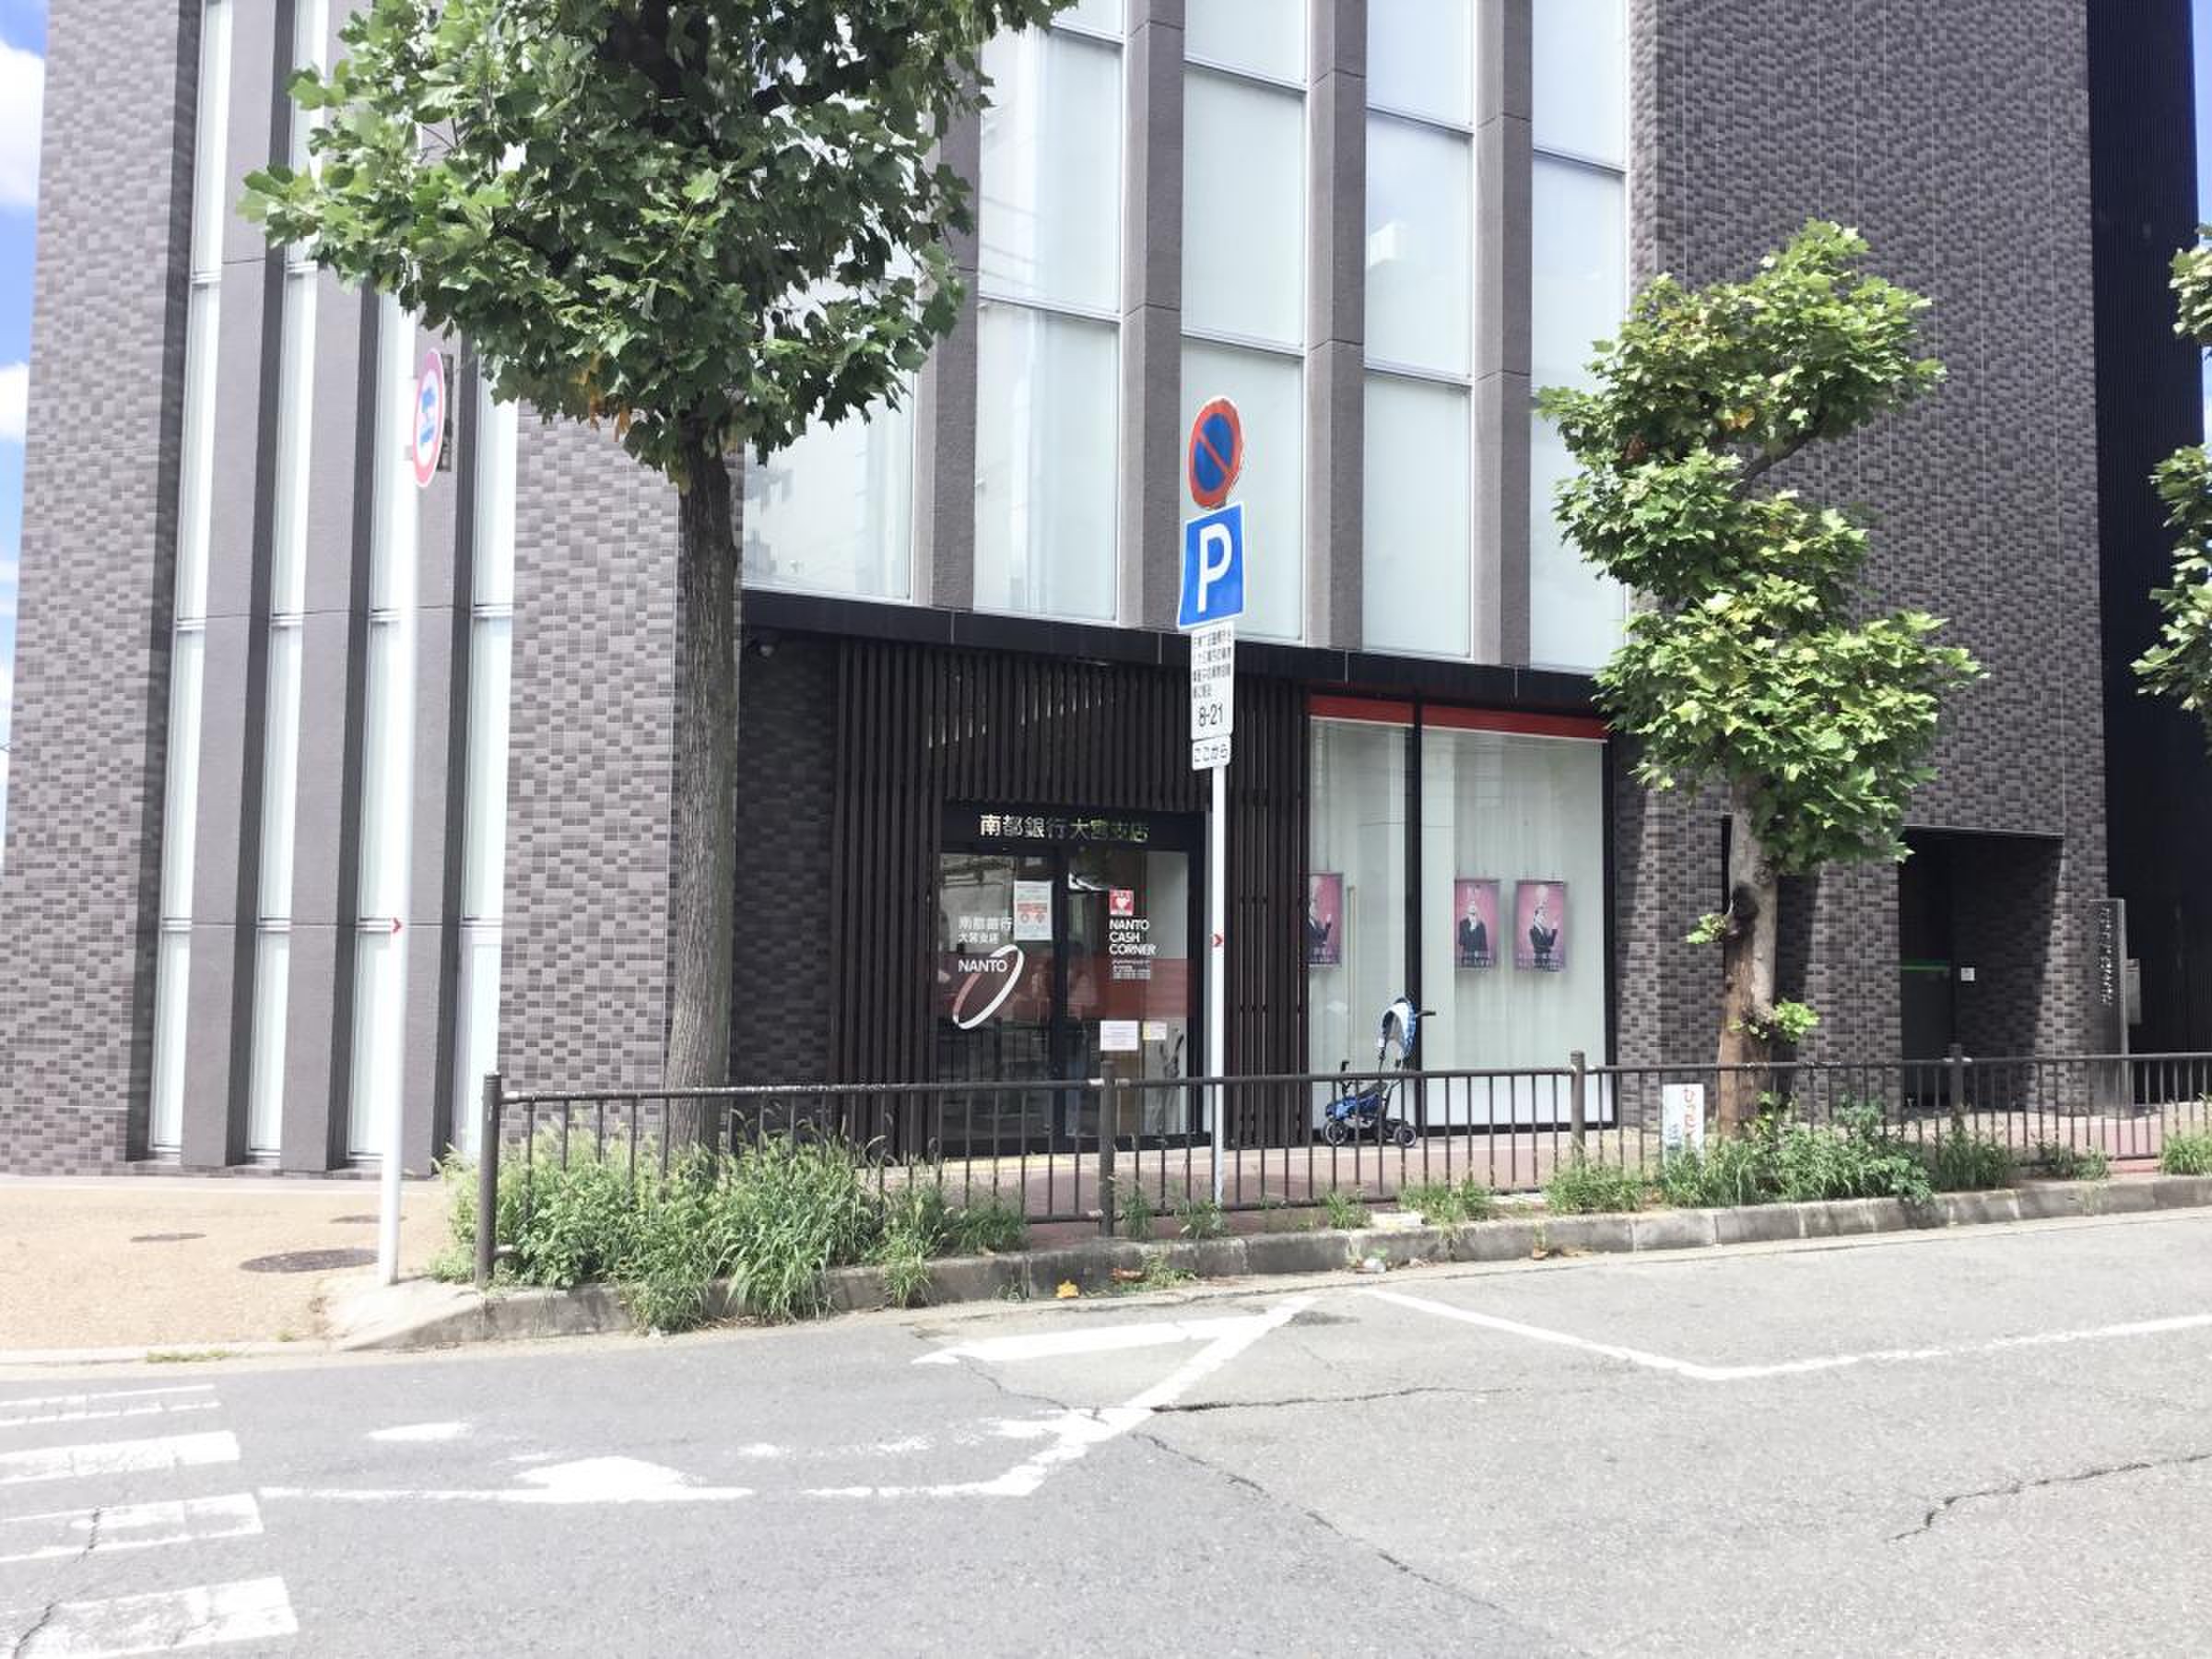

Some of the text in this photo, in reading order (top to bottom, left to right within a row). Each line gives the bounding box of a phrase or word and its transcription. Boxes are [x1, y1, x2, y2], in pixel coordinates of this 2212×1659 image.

[1197, 522, 1232, 613] P
[1199, 703, 1223, 727] 8-21
[1109, 919, 1150, 931] NANTO
[1109, 931, 1141, 943] CASH
[1109, 943, 1157, 955] CORNER
[959, 959, 1007, 972] NANTO
